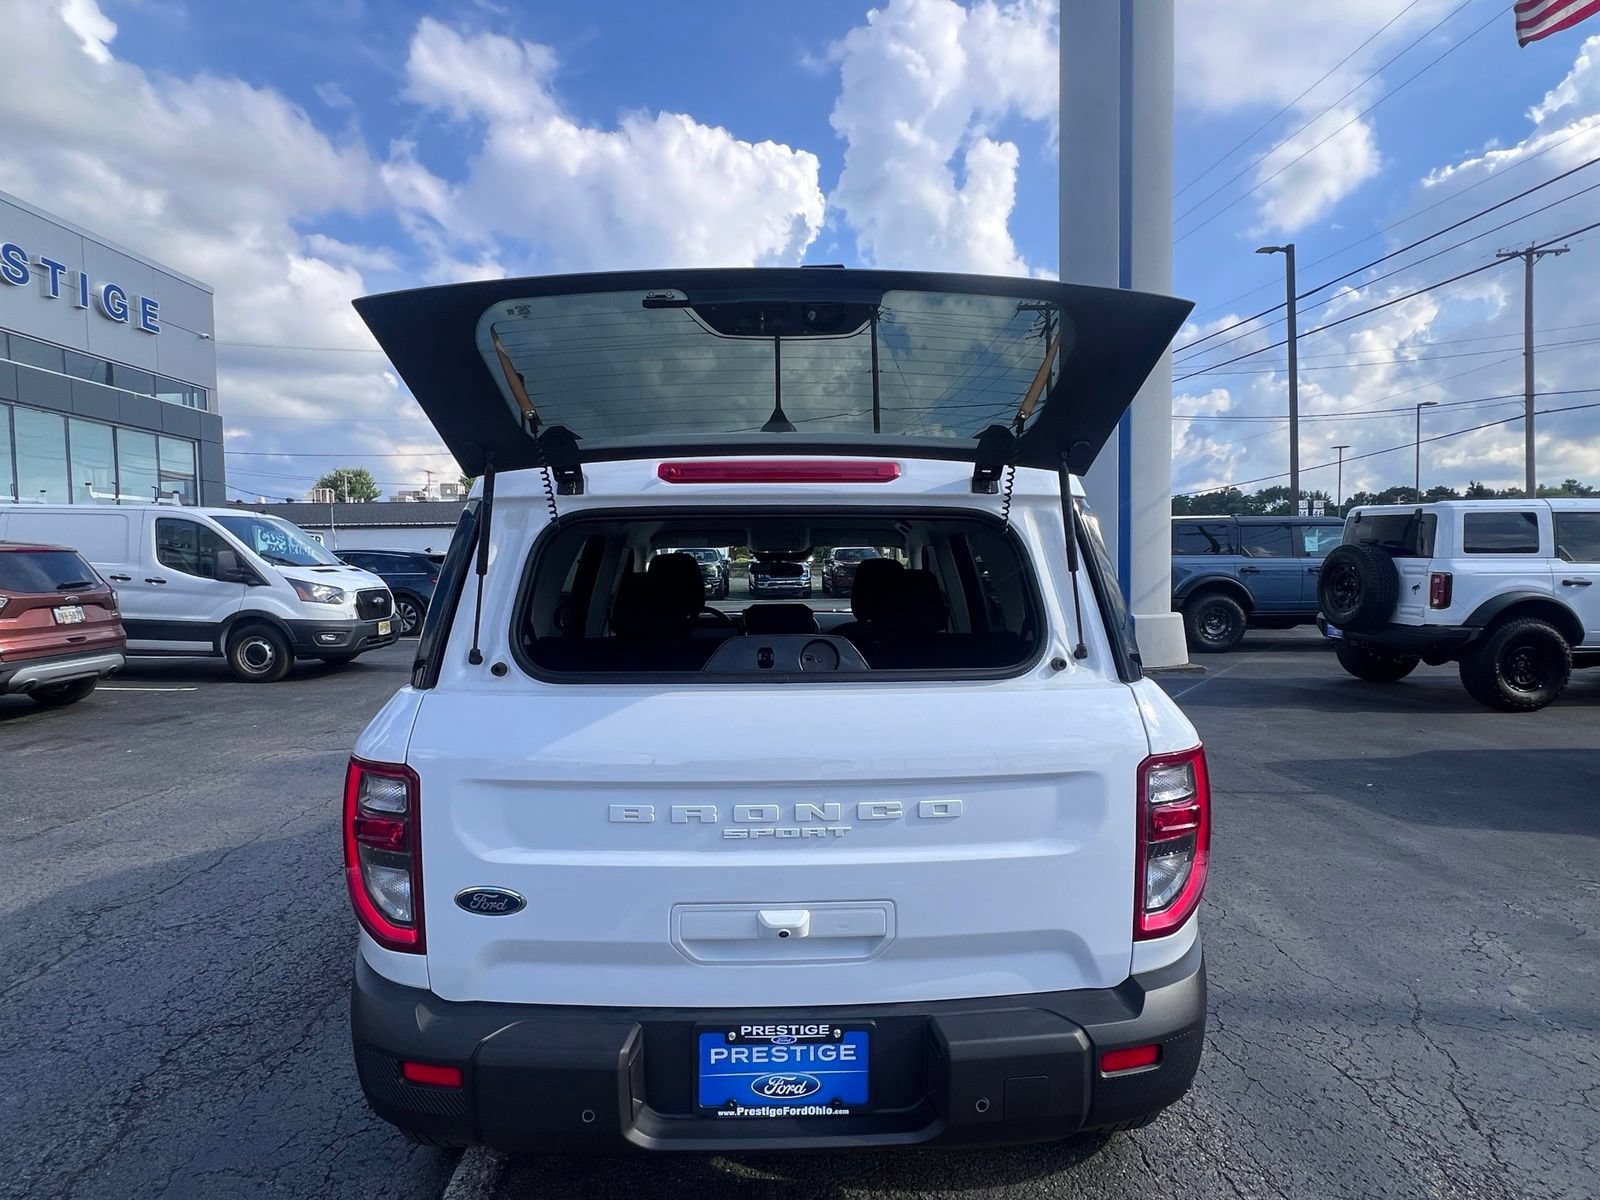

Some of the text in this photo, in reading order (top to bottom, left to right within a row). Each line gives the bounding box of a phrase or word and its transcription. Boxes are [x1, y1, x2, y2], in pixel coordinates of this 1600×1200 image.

[608, 799, 964, 824] BRONCO
[722, 826, 852, 839] SPORT
[469, 892, 508, 911] Ford
[740, 1025, 830, 1036] PRESTIGE
[710, 1044, 857, 1065] PRESTIGE
[763, 1075, 807, 1095] Ford
[717, 1106, 850, 1118] www.PrestigeFordOhio.com
